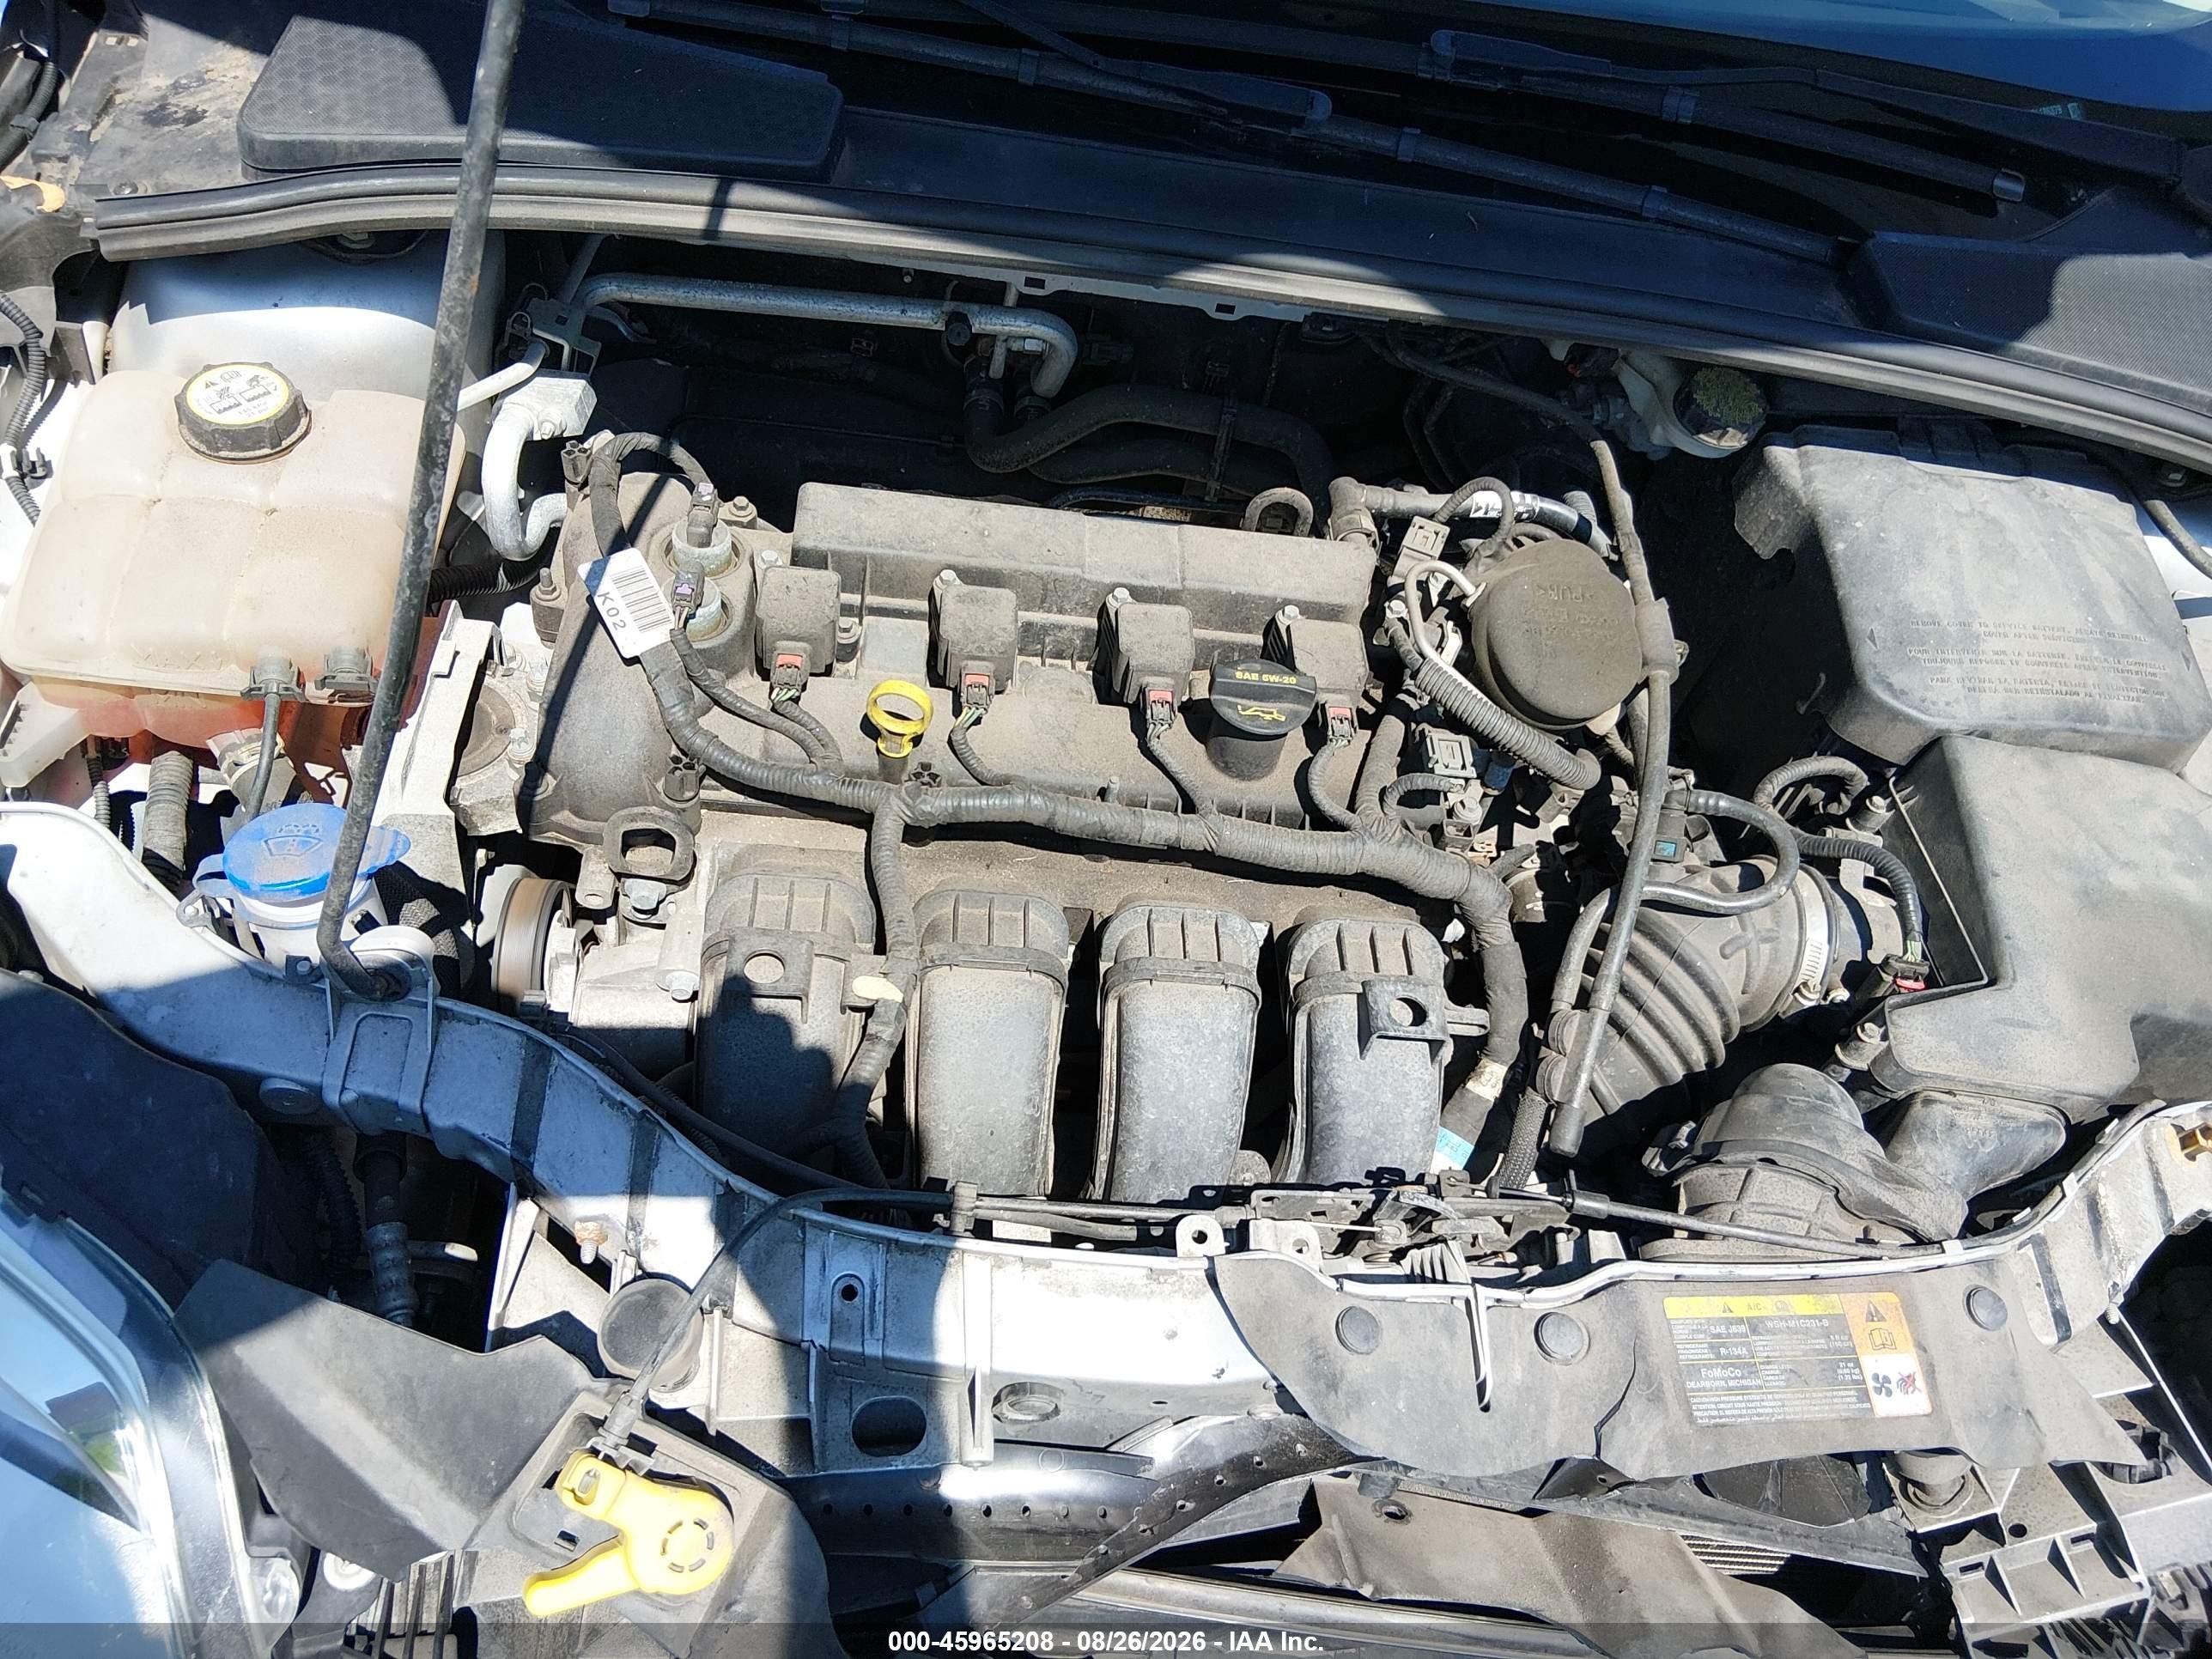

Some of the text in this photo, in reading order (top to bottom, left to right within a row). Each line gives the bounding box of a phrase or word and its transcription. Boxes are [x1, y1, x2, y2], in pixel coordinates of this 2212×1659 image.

[598, 592, 627, 631] K02
[1236, 671, 1259, 681] SAE
[1710, 1325, 1727, 1334] SAE
[1719, 1346, 1748, 1356] R-134A
[1700, 1367, 1742, 1378] FoMoCo
[1686, 1378, 1761, 1389] DEARBORN, MICHIGAN
